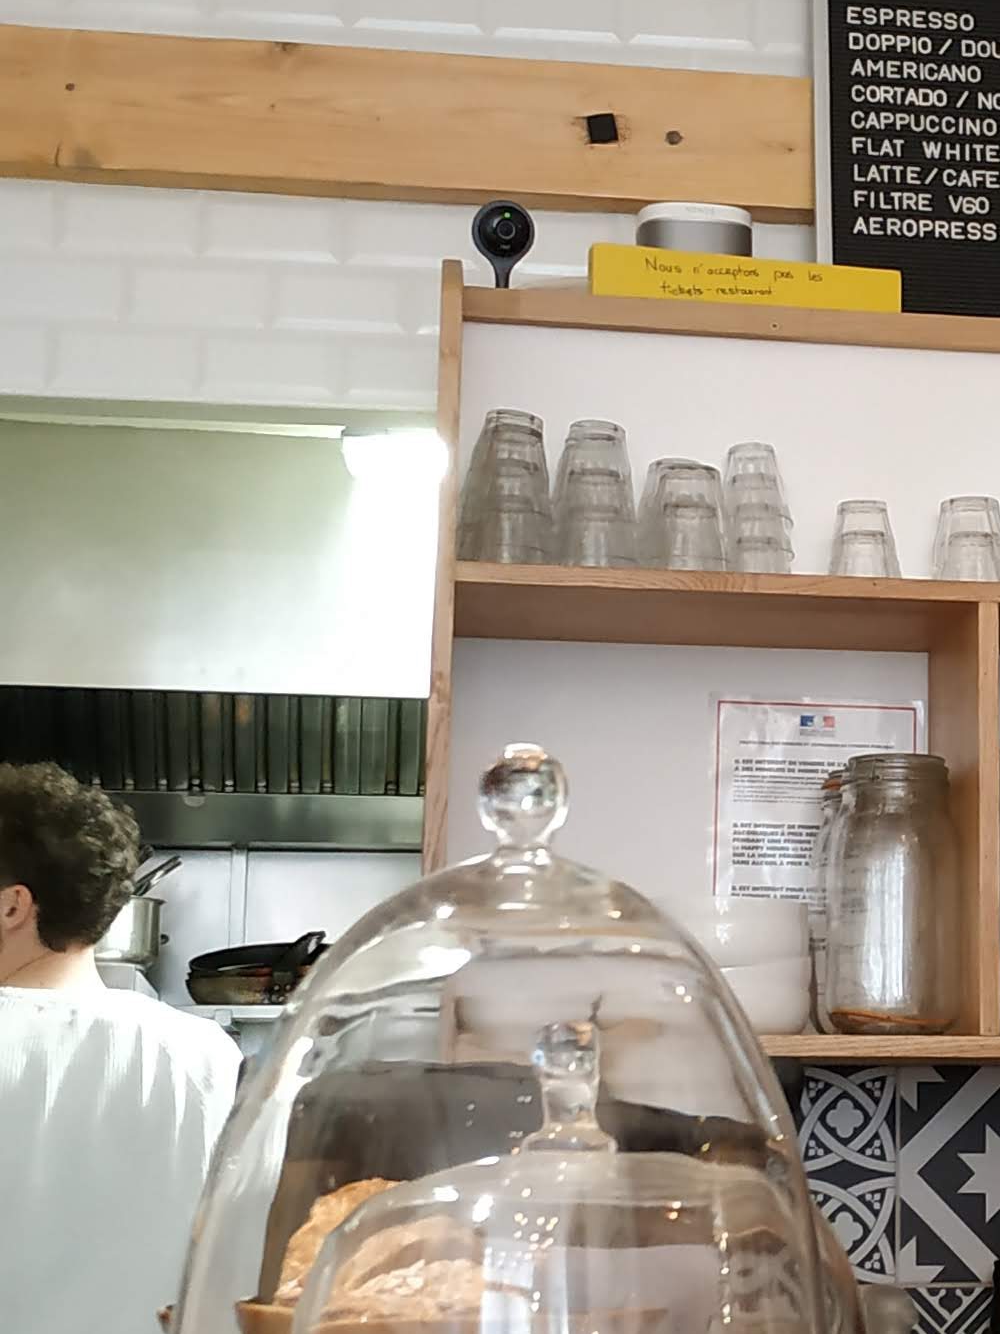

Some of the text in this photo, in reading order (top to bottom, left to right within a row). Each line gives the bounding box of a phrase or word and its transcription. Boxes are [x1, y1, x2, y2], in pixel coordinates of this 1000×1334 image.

[846, 6, 975, 32] ESPRESSO
[848, 32, 932, 55] DOPPIO
[851, 59, 981, 84] AMERICANO
[851, 85, 948, 108] CORTADO
[851, 111, 998, 137] CAPPUCCINO
[852, 137, 1000, 163] FLAT WHITE
[853, 190, 990, 215] FILTRE V60
[853, 217, 997, 241] AEROPRESS
[645, 256, 682, 274] Nous
